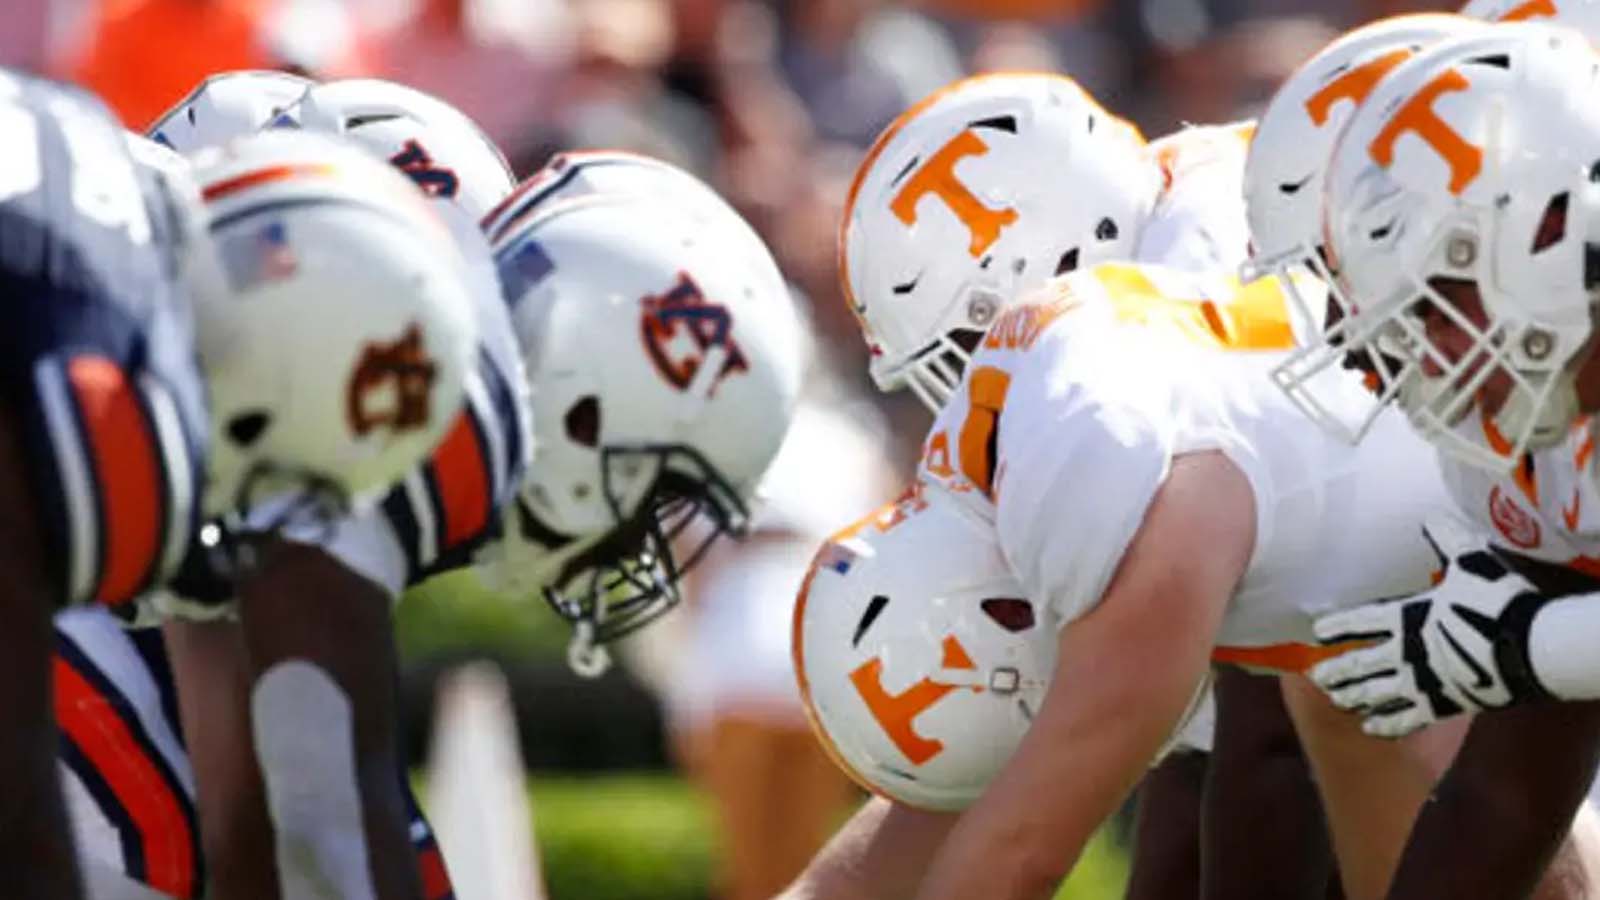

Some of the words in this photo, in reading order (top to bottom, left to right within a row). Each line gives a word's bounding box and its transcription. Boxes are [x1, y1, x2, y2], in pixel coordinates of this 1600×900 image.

[889, 129, 1020, 258] T
[1367, 68, 1483, 196] T
[849, 632, 979, 766] T
